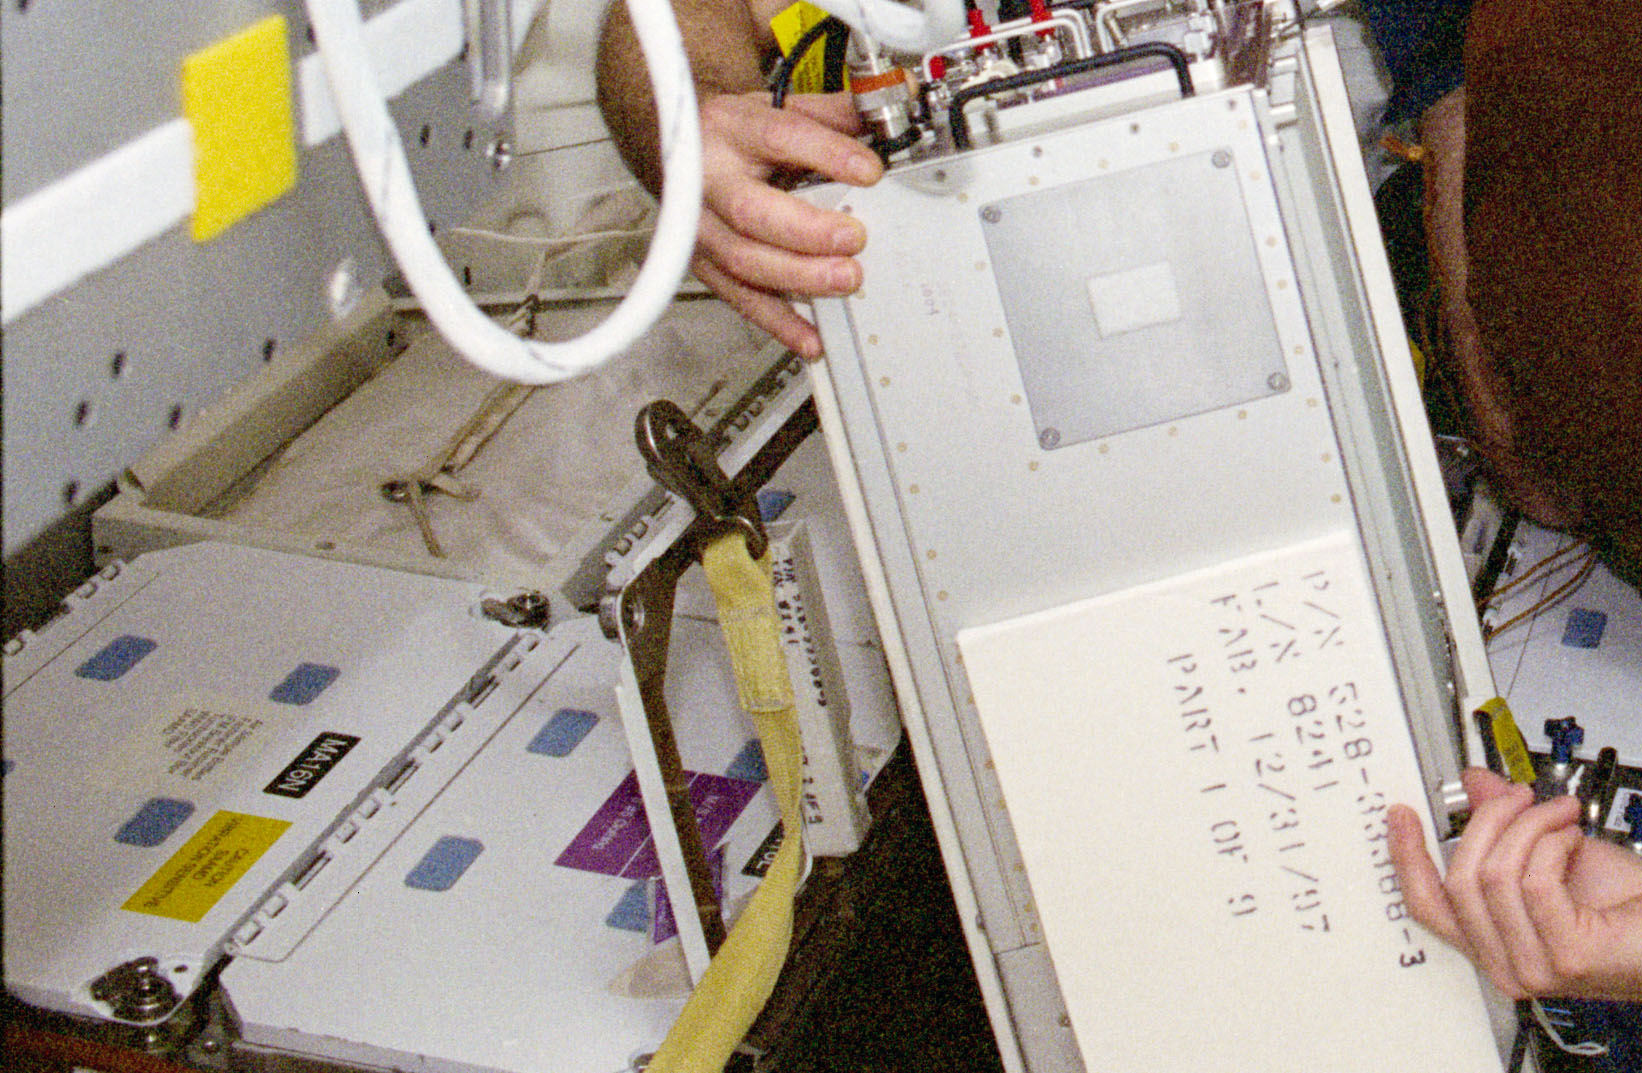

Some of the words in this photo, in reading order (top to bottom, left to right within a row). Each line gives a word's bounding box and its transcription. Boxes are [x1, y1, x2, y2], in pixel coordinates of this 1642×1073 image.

[1302, 570, 1345, 647] P/N
[1167, 654, 1219, 753] PART
[1253, 581, 1303, 662] L/N
[1288, 694, 1341, 792] 8241
[278, 739, 348, 791] MA16N
[1200, 784, 1227, 794] 1
[1211, 594, 1258, 695] FAB.
[1250, 733, 1330, 932] 12/31/97
[204, 848, 249, 888] CAUTION
[1211, 820, 1250, 864] OF
[1228, 894, 1258, 918] 9
